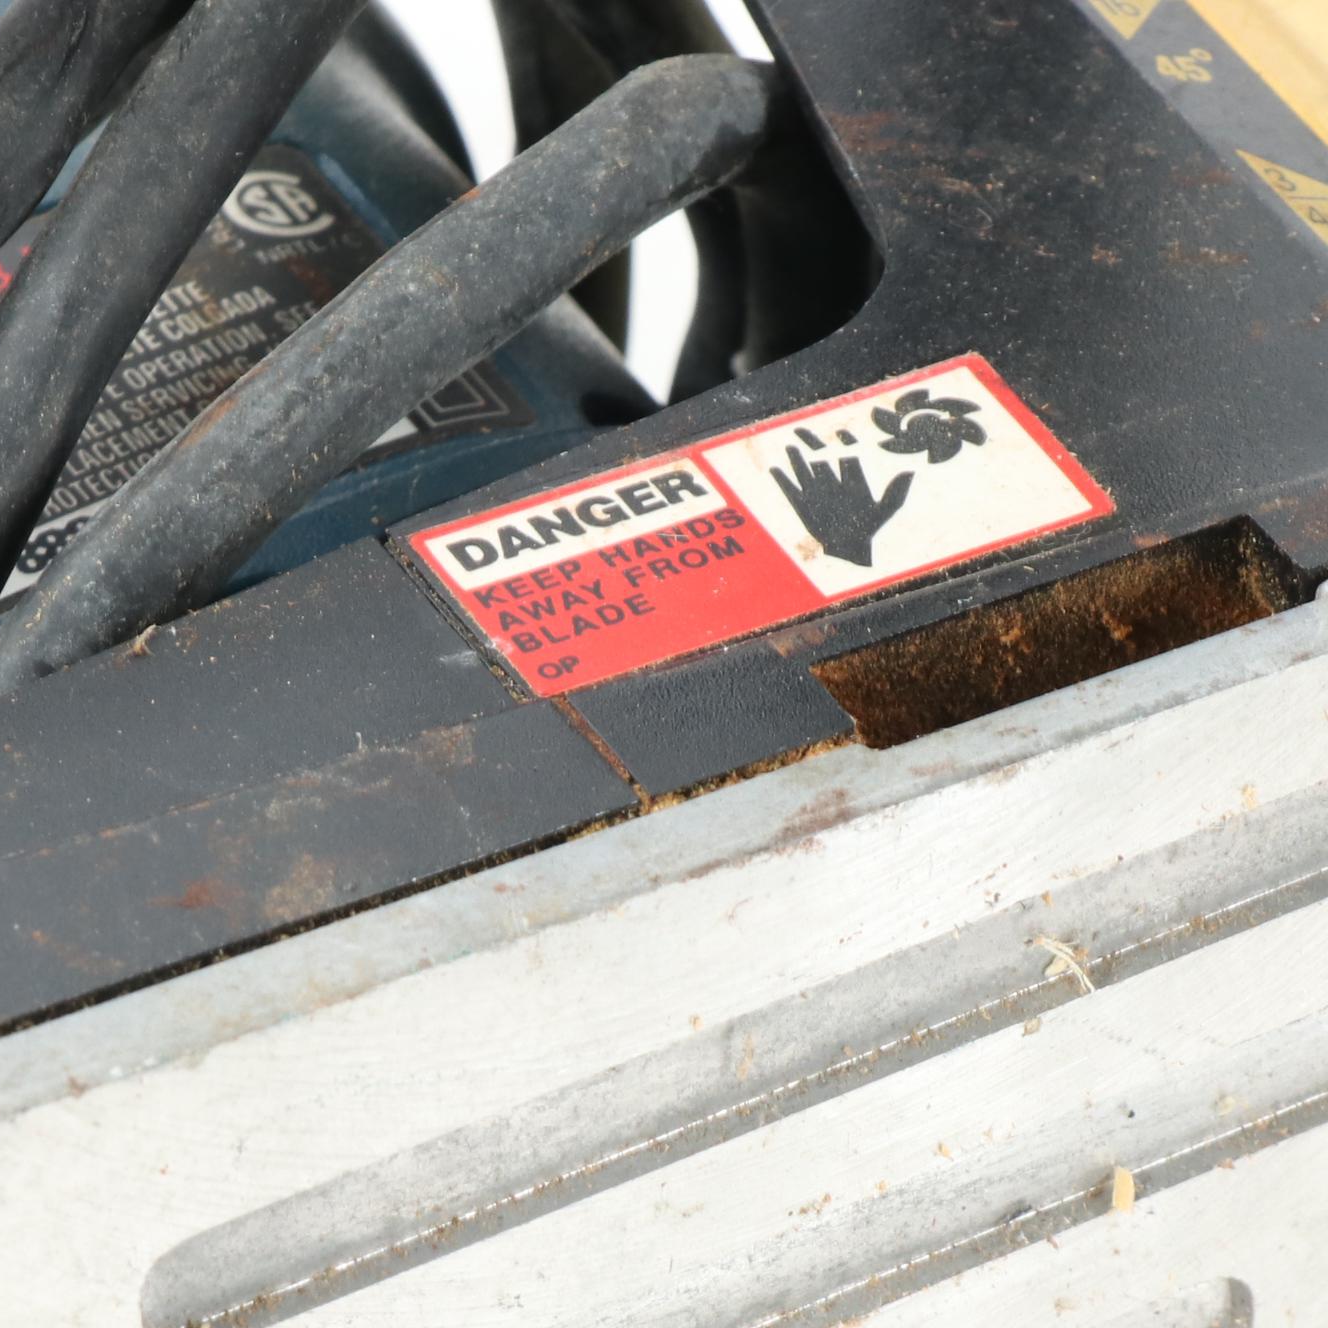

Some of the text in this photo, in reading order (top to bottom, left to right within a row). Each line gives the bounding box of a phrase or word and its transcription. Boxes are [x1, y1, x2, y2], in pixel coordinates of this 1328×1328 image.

[159, 285, 277, 342] COLGADA
[445, 469, 708, 573] DANGER
[473, 508, 748, 608] KEEP HANDS
[497, 535, 746, 632] AWAY FROM
[511, 593, 657, 654] BLADE
[536, 655, 582, 682] OP
